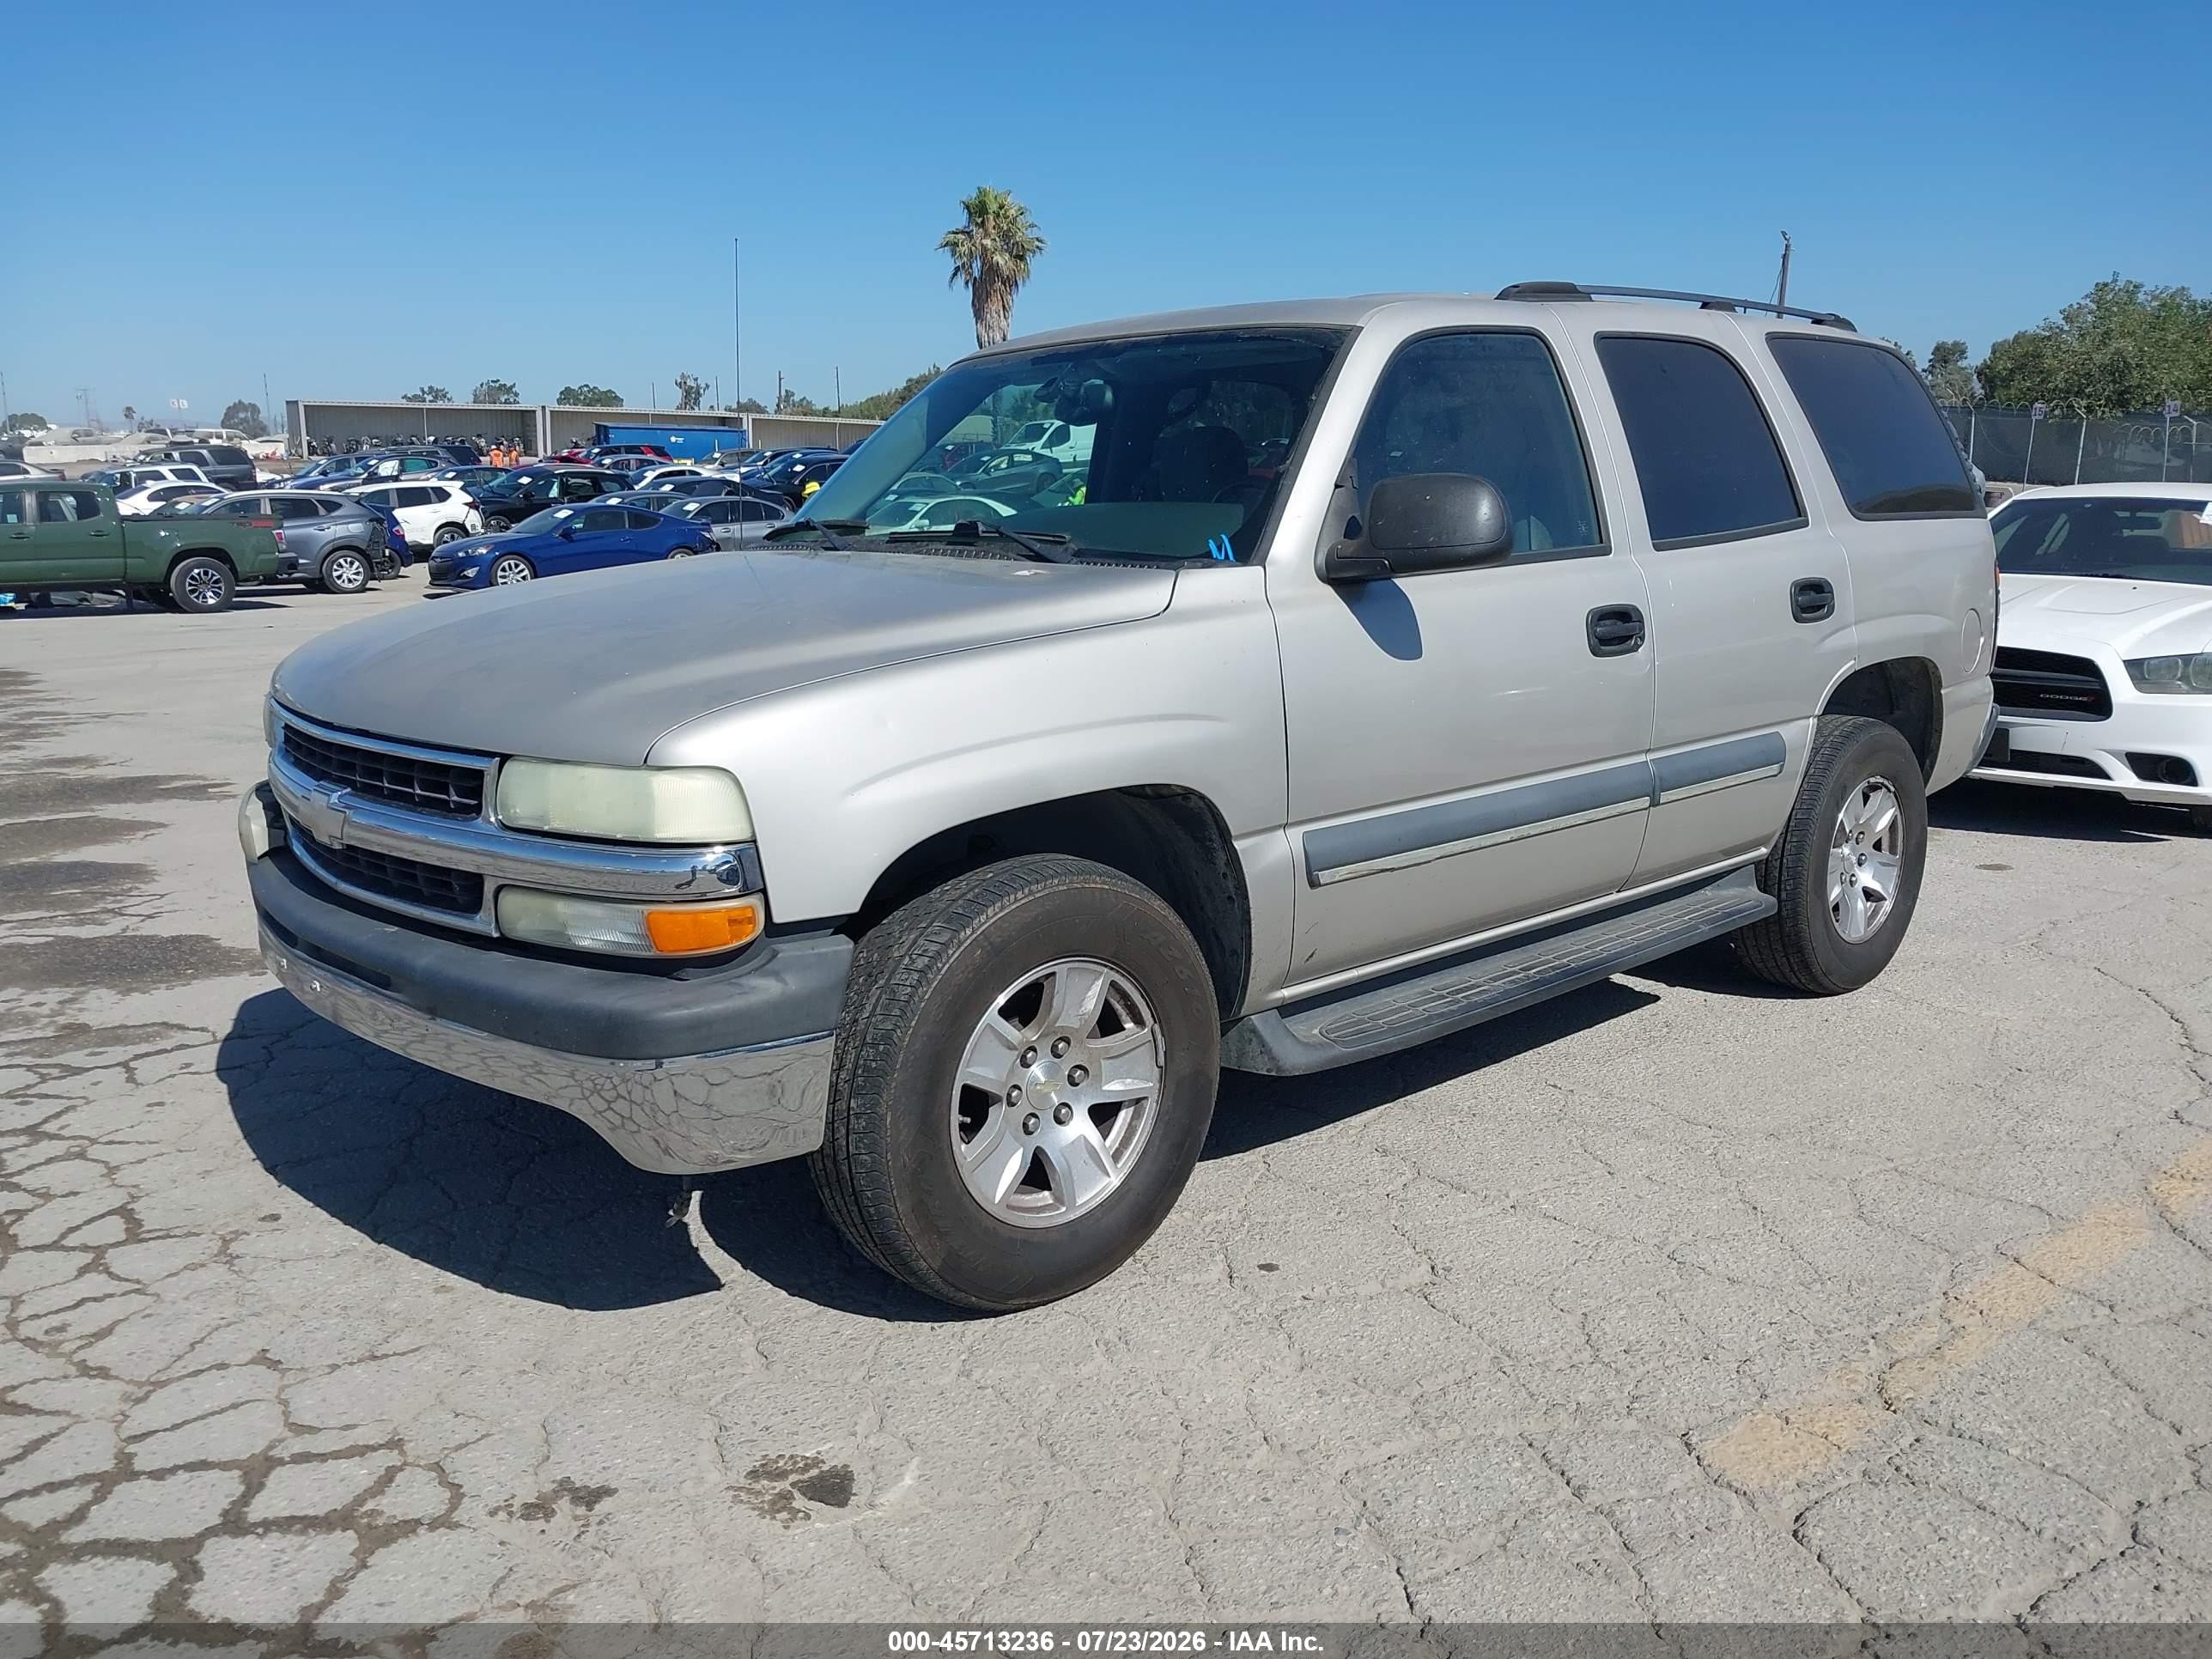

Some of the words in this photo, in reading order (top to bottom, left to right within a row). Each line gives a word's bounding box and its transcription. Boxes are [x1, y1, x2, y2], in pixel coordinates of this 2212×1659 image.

[2033, 406, 2044, 416] 15
[2166, 404, 2179, 414] 14
[2039, 693, 2087, 702] DODGE
